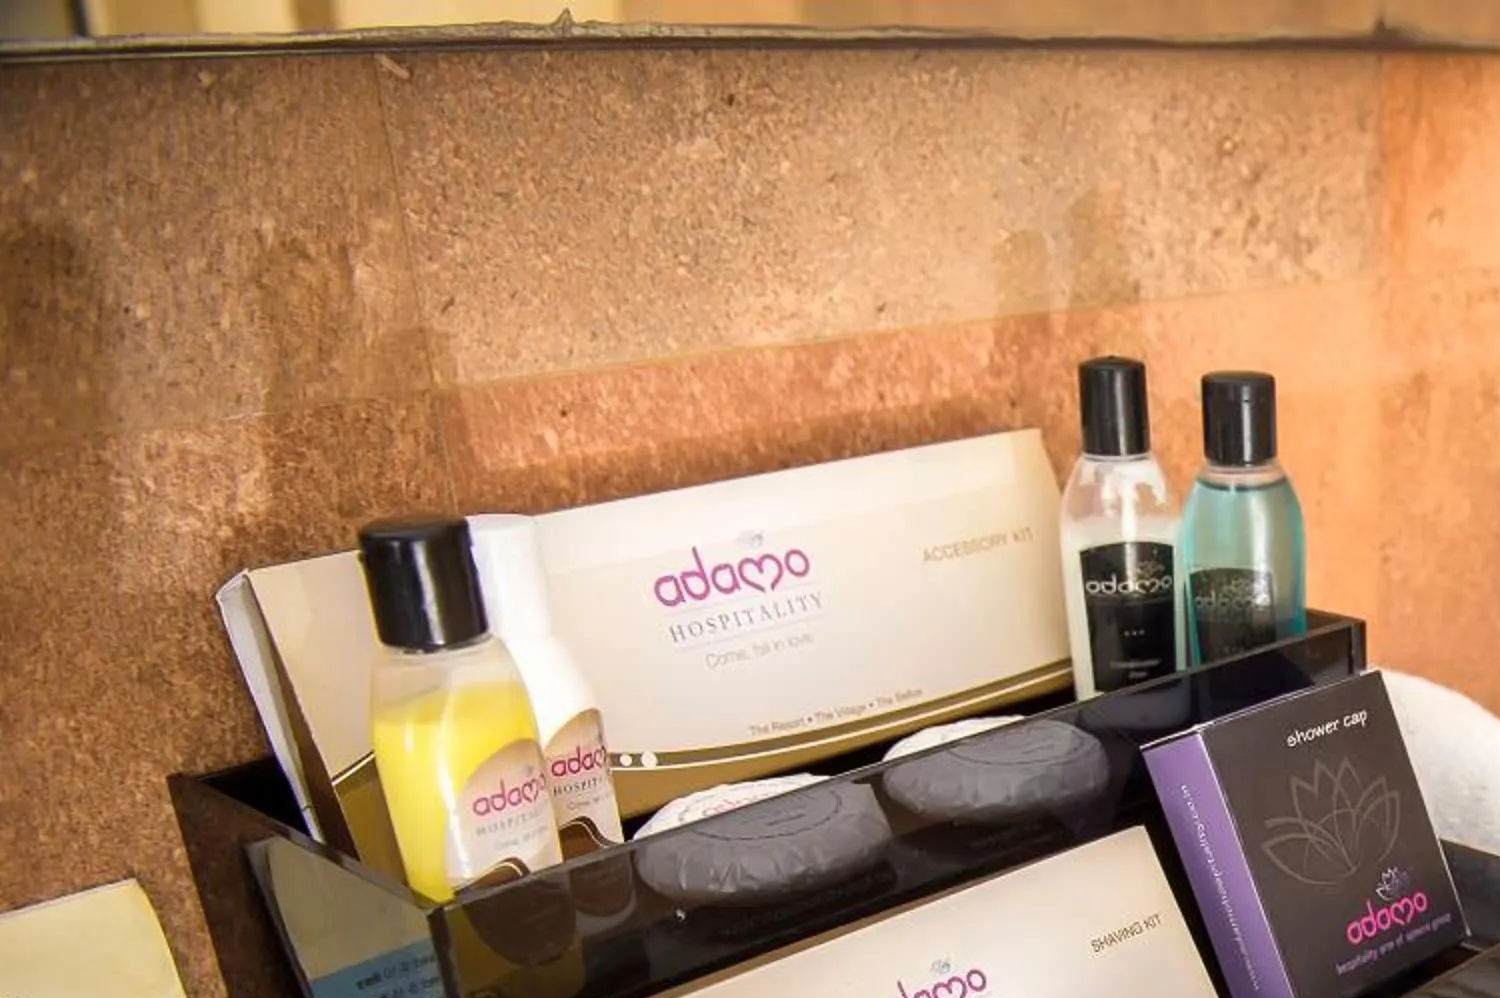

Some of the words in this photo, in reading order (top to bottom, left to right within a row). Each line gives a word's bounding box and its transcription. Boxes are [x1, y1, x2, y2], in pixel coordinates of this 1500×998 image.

[923, 533, 1007, 563] ACCESSORY
[1012, 526, 1034, 543] KIT
[654, 546, 810, 607] adamo
[1086, 573, 1173, 594] adamo
[668, 591, 822, 643] HOSPITALITY
[750, 724, 769, 736] The
[814, 709, 835, 722] The
[1286, 719, 1340, 748] shower
[1343, 709, 1368, 729] cap
[551, 744, 607, 777] adam
[1090, 921, 1144, 954] SHAVING
[1143, 912, 1162, 931] KIT
[1346, 891, 1428, 945] adamo
